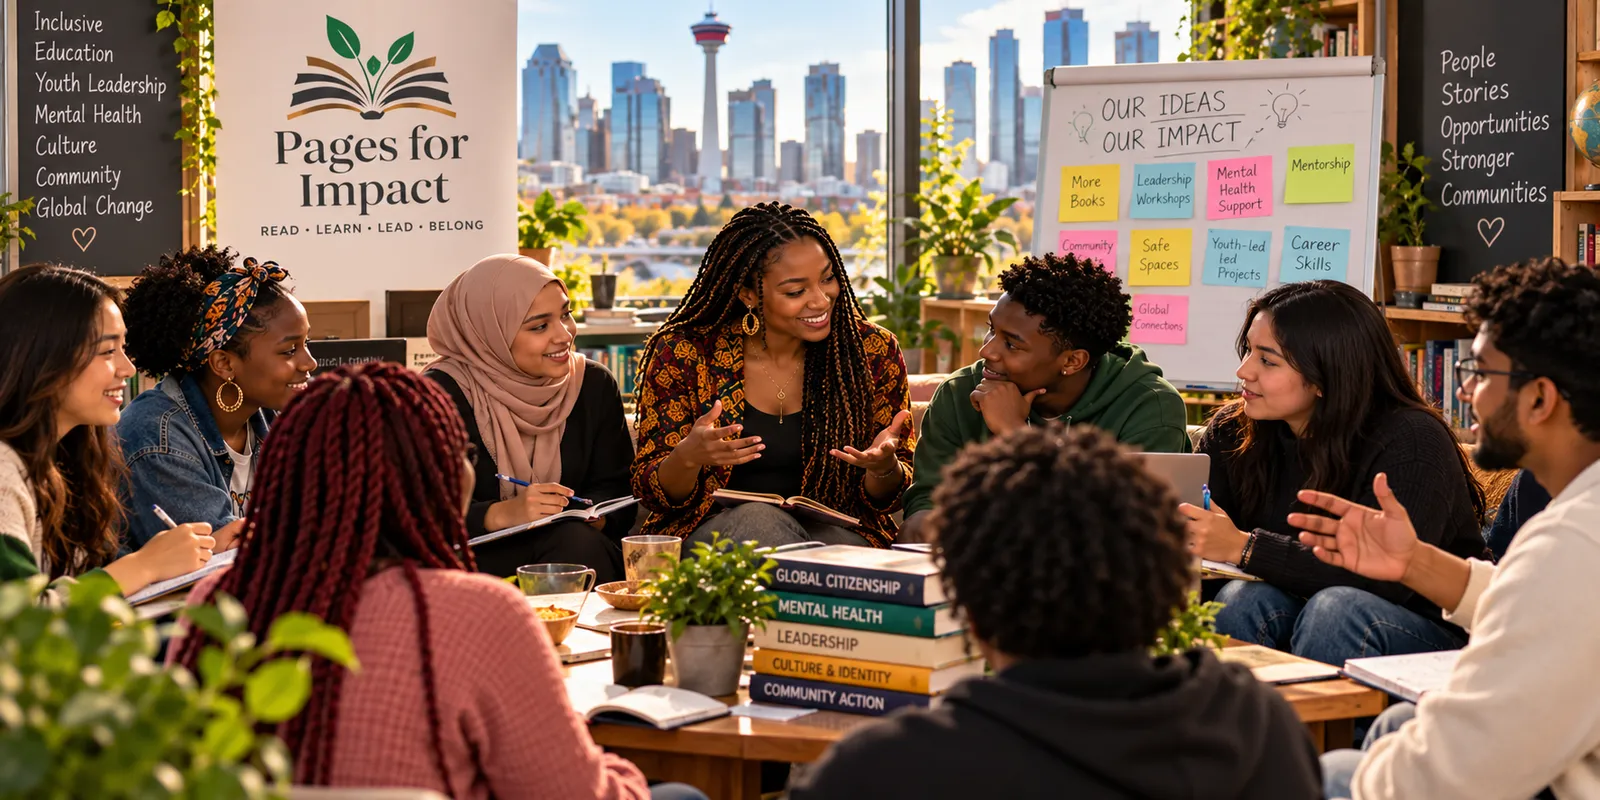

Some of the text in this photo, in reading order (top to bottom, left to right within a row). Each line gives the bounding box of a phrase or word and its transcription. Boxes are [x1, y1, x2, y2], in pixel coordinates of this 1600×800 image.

[34, 10, 104, 33] Inclusive
[35, 41, 114, 63] Education
[1440, 45, 1496, 78] People
[35, 72, 167, 102] Youth Leadership
[1441, 81, 1509, 106] Stories
[35, 103, 142, 124] Mental Health
[1102, 90, 1226, 121] OUR IDEAS
[1103, 121, 1242, 153] OUR IMPACT
[1441, 111, 1550, 145] Opportunities
[36, 134, 97, 156] Culture
[274, 124, 469, 174] Pages for
[1217, 164, 1257, 180] Mental
[1292, 157, 1351, 174] Mentorship
[1441, 148, 1515, 177] Stronger
[36, 165, 121, 191] Community
[1071, 175, 1101, 189] More
[1137, 173, 1192, 189] Leadership
[1220, 182, 1256, 196] Health
[300, 173, 450, 216] Impact
[1070, 194, 1106, 208] Books
[1137, 192, 1191, 208] Workshops
[1441, 181, 1547, 207] Communities
[36, 194, 153, 222] Global Change
[1218, 198, 1263, 215] Support
[260, 220, 484, 236] READ LEARN LEAD BELONG
[1062, 239, 1114, 255] Community
[1142, 238, 1170, 253] Safe
[1212, 237, 1266, 252] Youth-led
[1291, 235, 1340, 252] Career
[1139, 257, 1179, 272] Spaces
[1295, 256, 1331, 271] Skills
[1218, 267, 1261, 283] Projects
[1138, 303, 1170, 316] Global
[1135, 318, 1184, 332] Connections
[776, 568, 901, 595] GLOBAL CITIZENSHIP
[778, 598, 883, 625] MENTAL HEALTH
[777, 629, 859, 651] LEADERSHIP
[773, 657, 892, 684] CULTURE & IDENTITY
[764, 682, 885, 711] COMMUNITY ACTION
